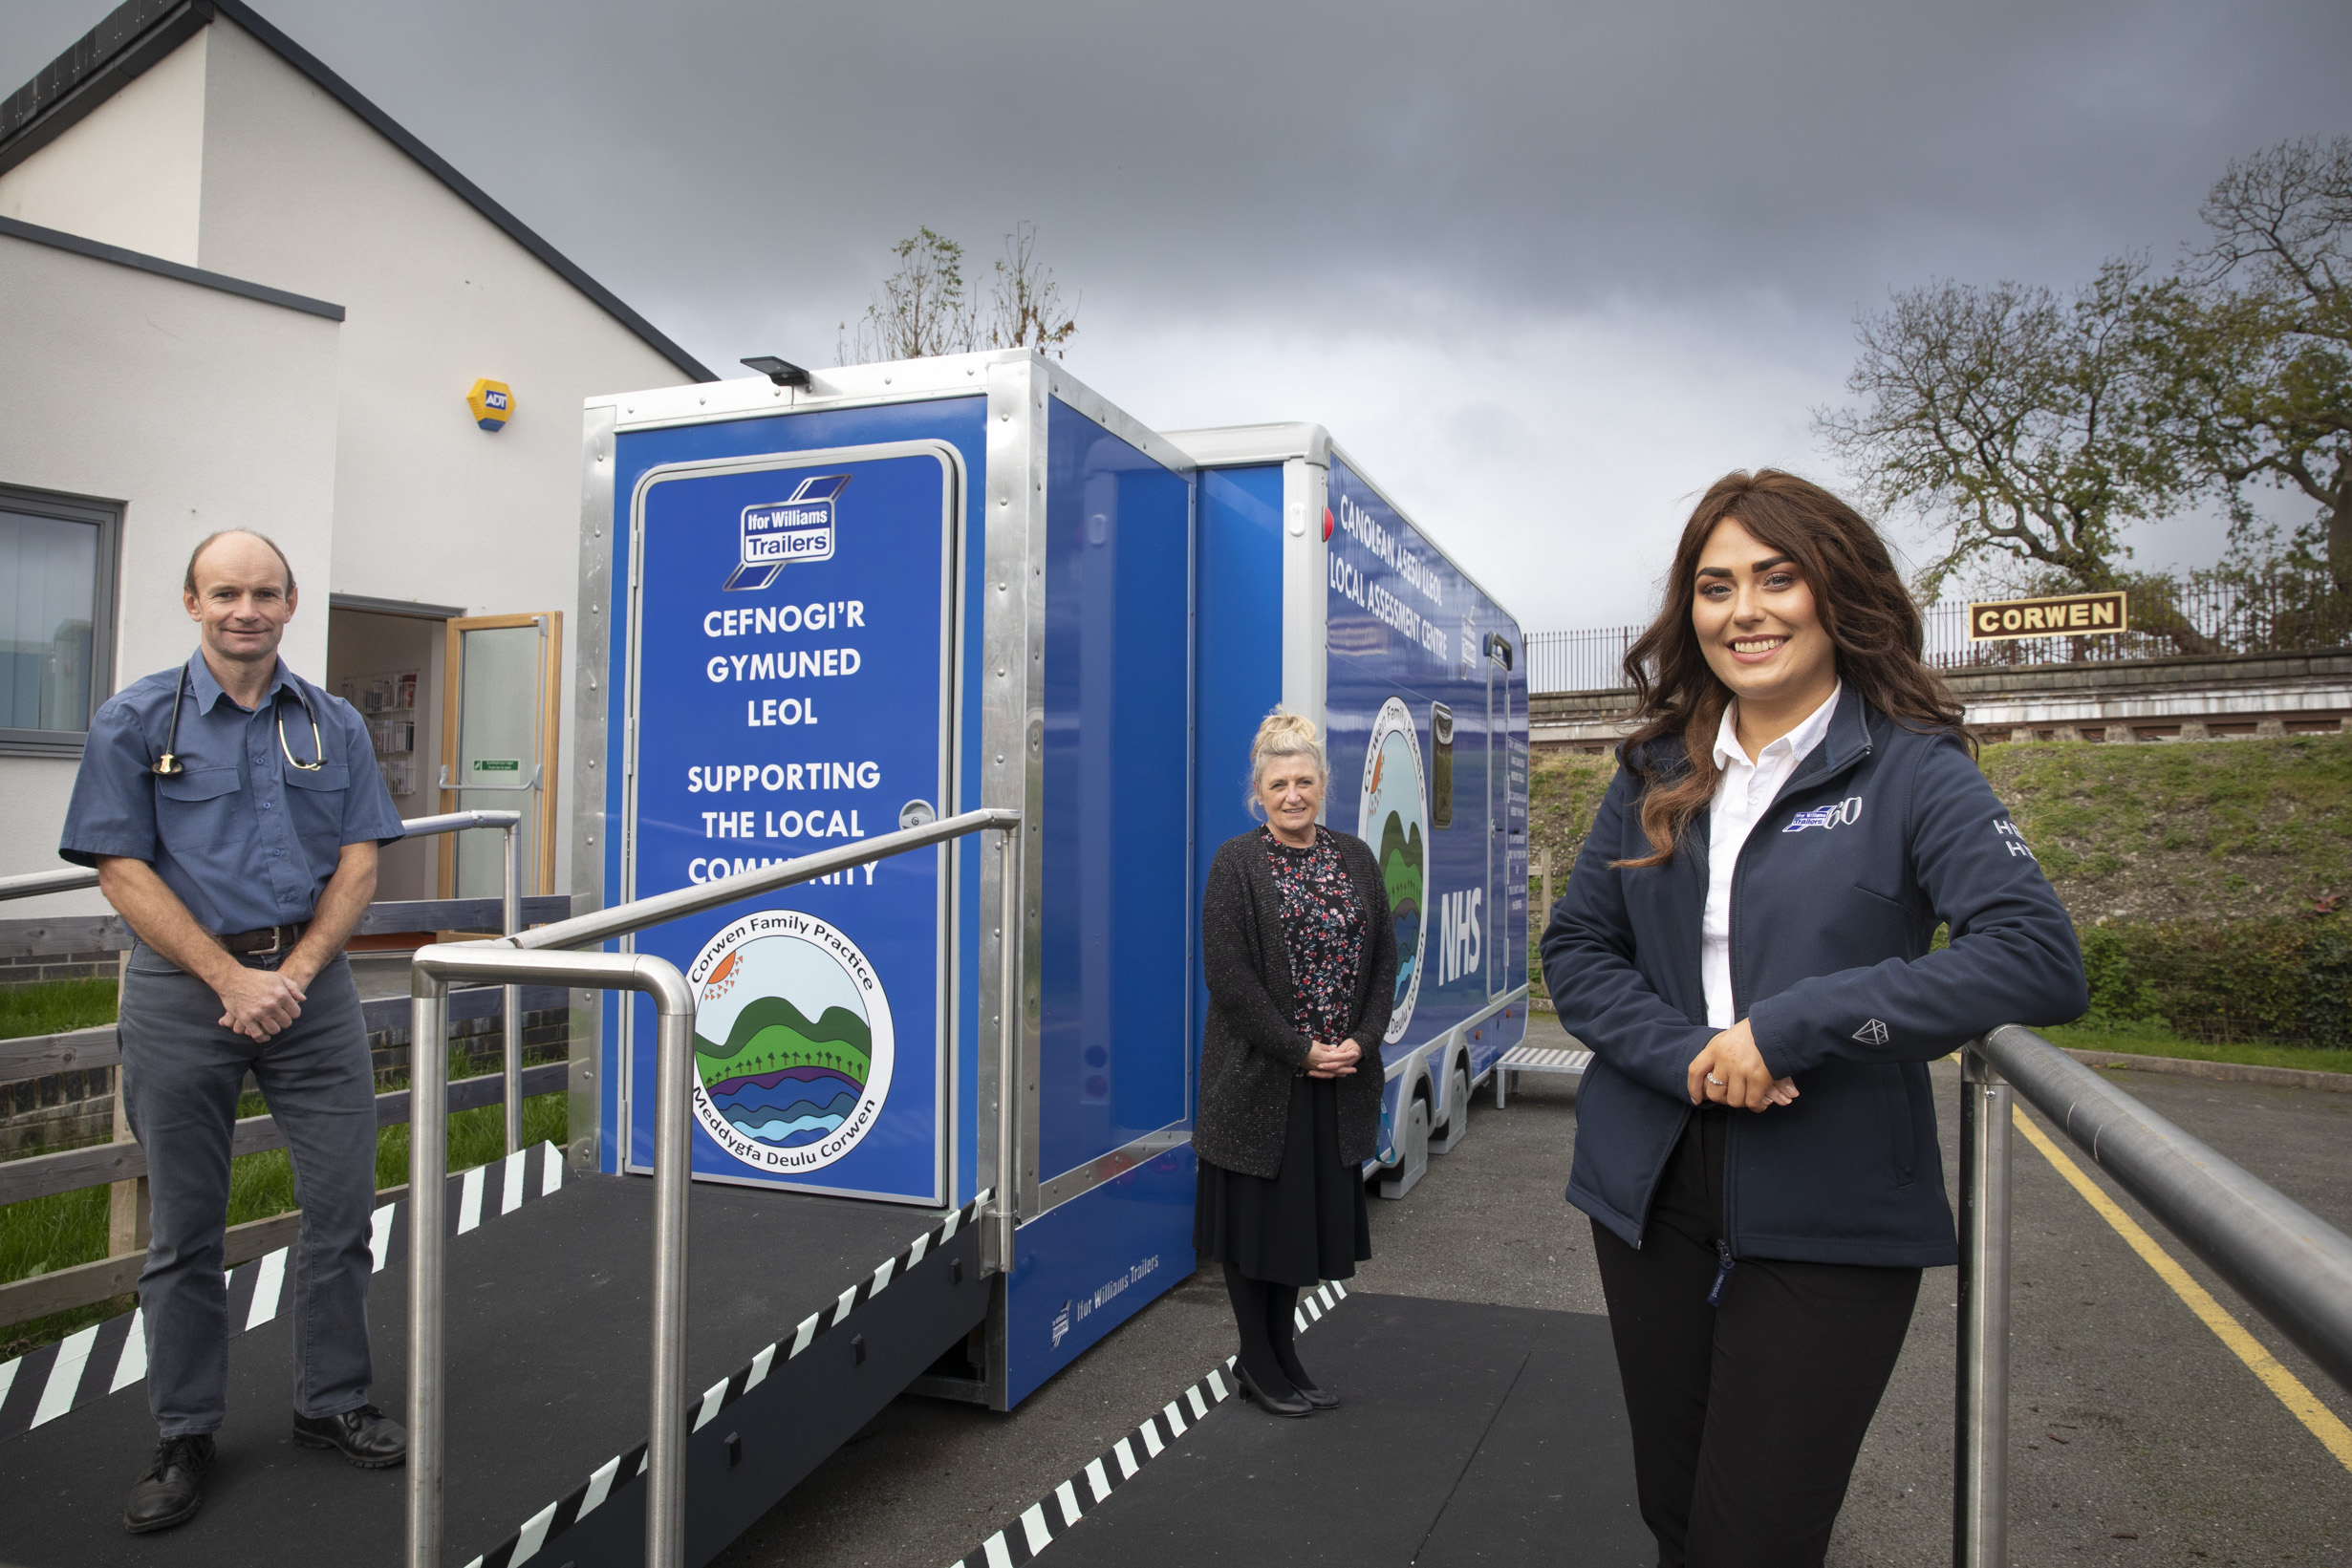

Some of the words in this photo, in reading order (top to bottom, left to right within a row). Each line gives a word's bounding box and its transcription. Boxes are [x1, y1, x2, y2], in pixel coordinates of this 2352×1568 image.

[486, 393, 507, 408] ADT
[747, 513, 770, 531] Ifor
[771, 509, 828, 528] Williams
[748, 535, 827, 555] Trailers
[1340, 494, 1395, 569] CANOLFAN
[1396, 544, 1421, 590] ASESU
[1422, 566, 1442, 607] LLEOL
[703, 600, 865, 637] CEFNOGI'R
[1329, 551, 1365, 609] LOCAL
[1367, 580, 1421, 643] ASSESSMENT
[1421, 619, 1447, 661] CENTRE
[1978, 601, 2115, 633] CORWEN
[706, 648, 861, 682] GYMUNED
[747, 698, 818, 727] LEOL
[1364, 715, 1387, 793] Corwen
[1387, 705, 1408, 731] Family
[687, 762, 880, 793] SUPPORTING
[701, 811, 754, 838] THE
[766, 809, 865, 837] LOCAL
[687, 857, 879, 886] COMITY
[691, 926, 746, 984] Corwen
[750, 915, 809, 934] Family
[813, 924, 873, 991] Practice
[1438, 887, 1481, 986] NHS
[693, 1085, 761, 1161] Meddygfa
[766, 1151, 816, 1167] Deulu
[820, 1098, 875, 1158] Corwen
[1077, 1299, 1091, 1321] Ifor
[1094, 1275, 1129, 1309] Williams
[1130, 1254, 1158, 1283] Trailers
